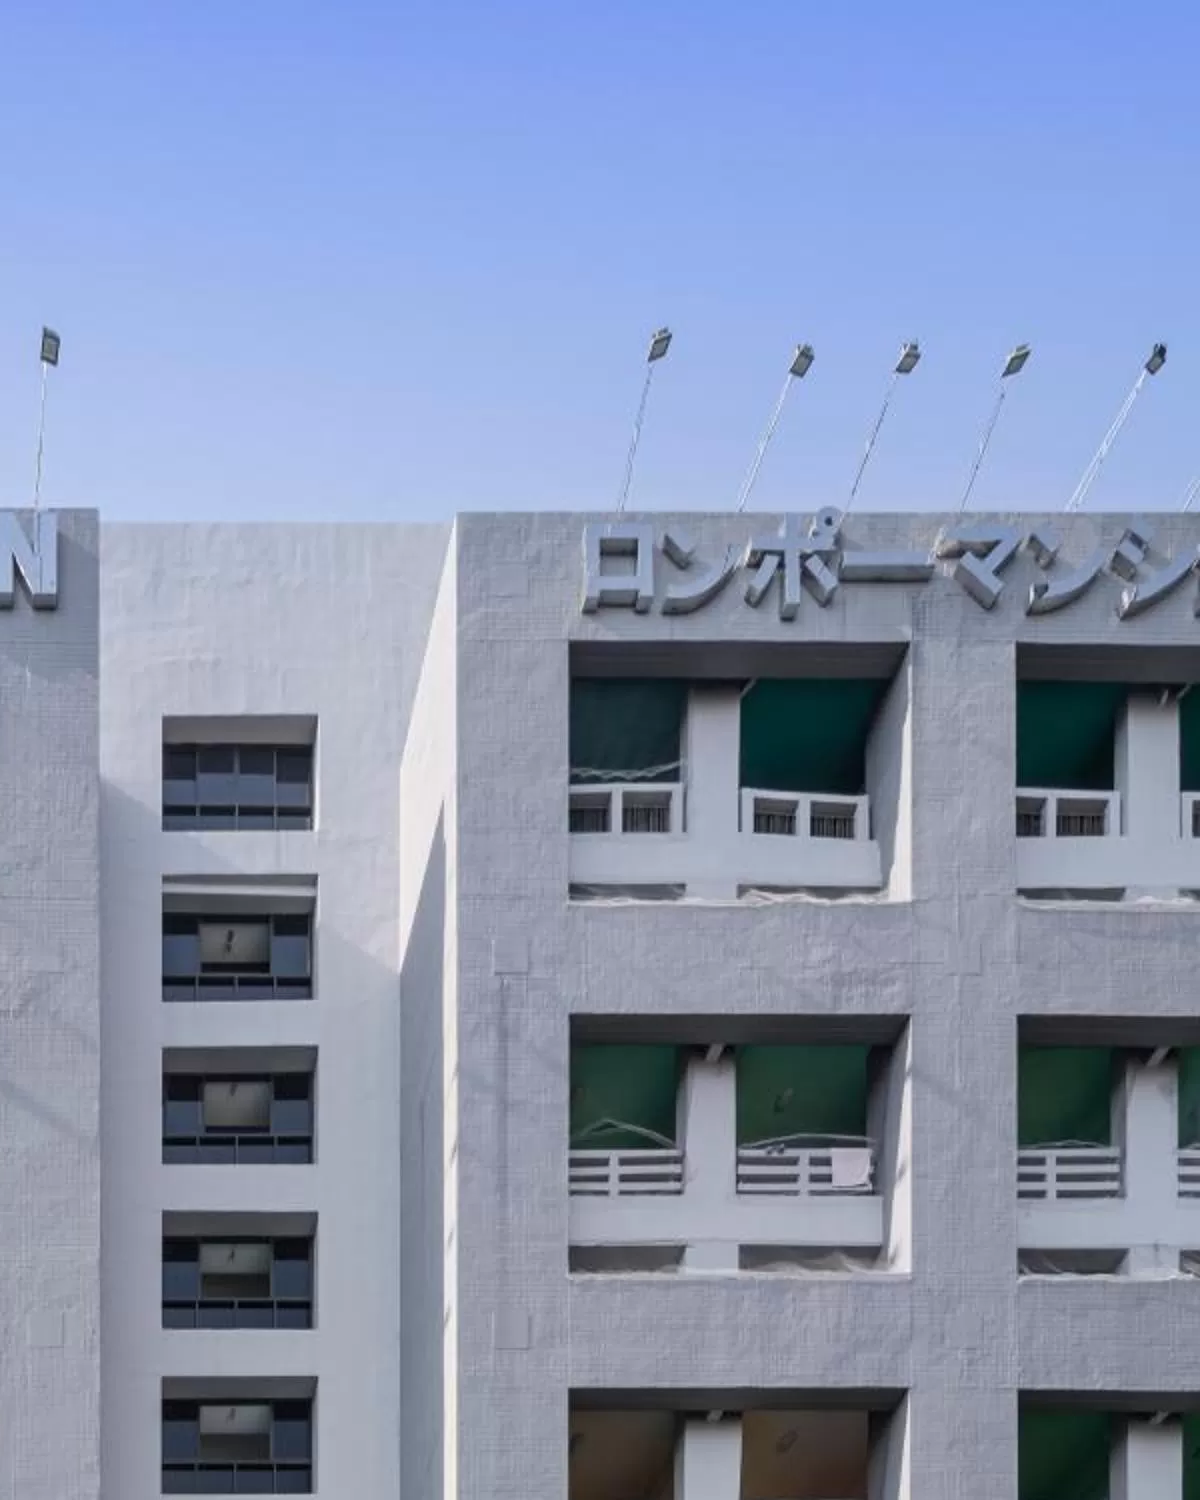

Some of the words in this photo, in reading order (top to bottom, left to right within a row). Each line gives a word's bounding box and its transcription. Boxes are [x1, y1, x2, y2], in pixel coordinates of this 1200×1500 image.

[582, 505, 1200, 621] ロンポーマンシ
